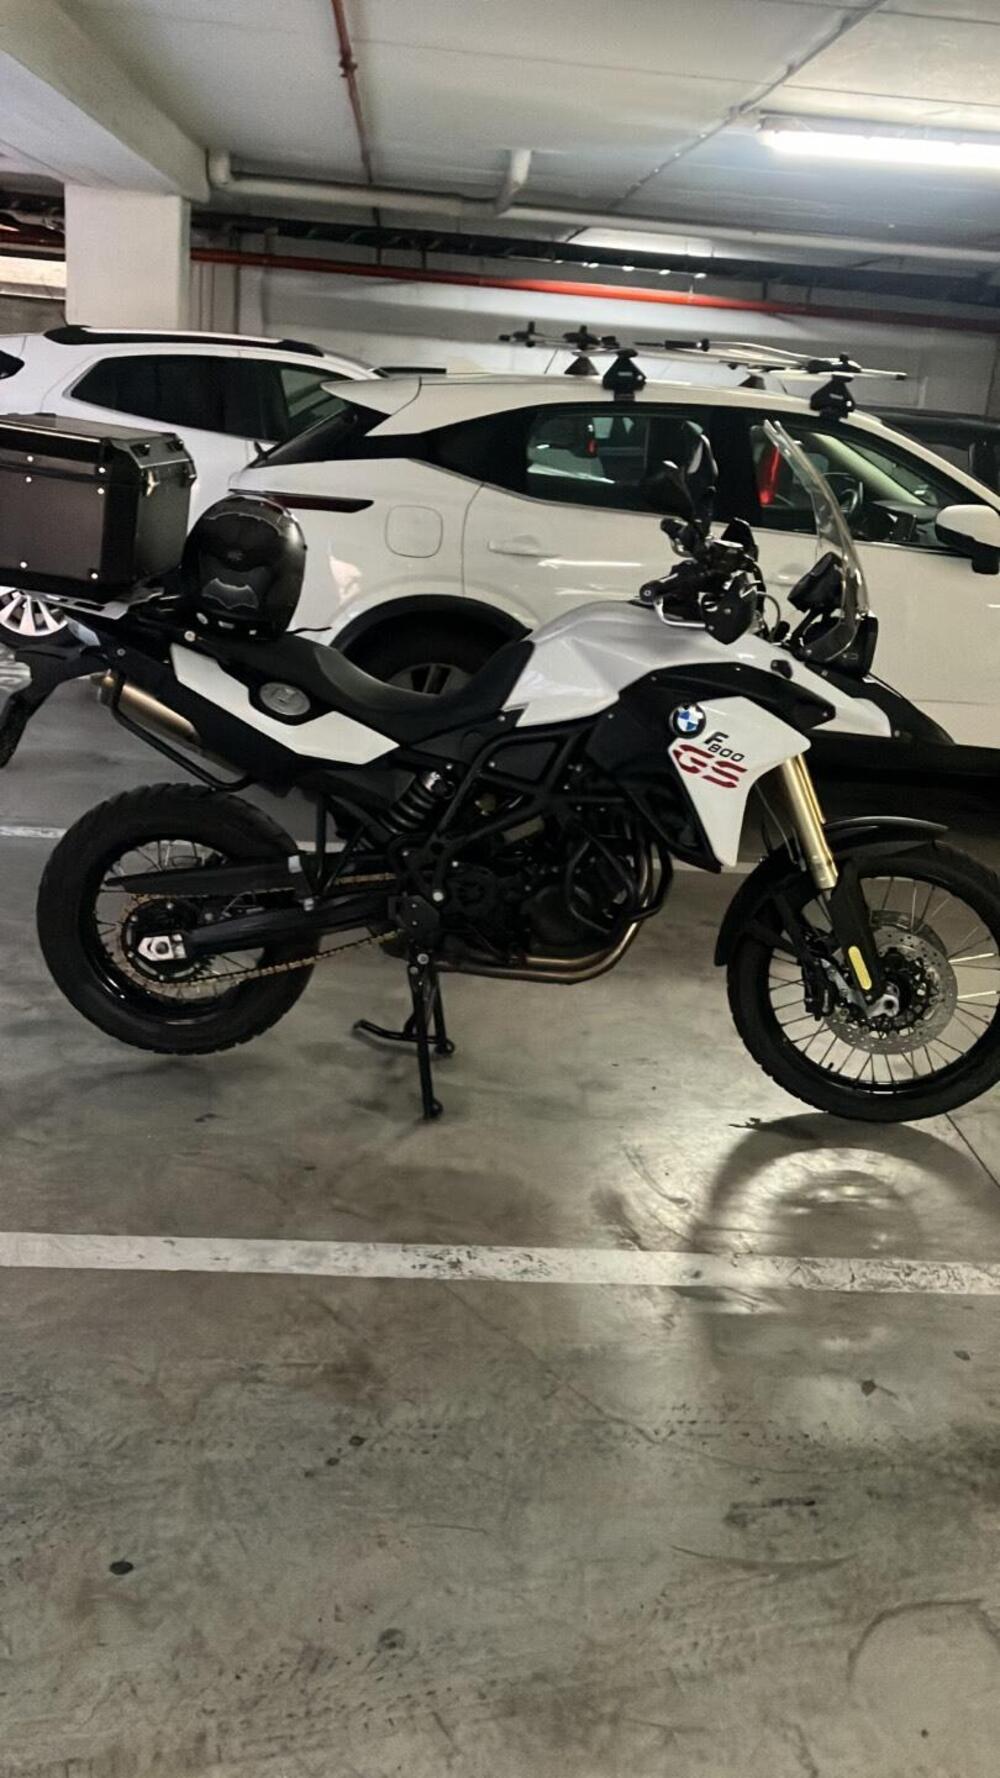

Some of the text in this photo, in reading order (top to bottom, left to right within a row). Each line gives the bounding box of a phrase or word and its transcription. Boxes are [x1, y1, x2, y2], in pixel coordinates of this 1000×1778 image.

[704, 731, 729, 745] F
[707, 743, 745, 762] 800
[672, 744, 748, 788] GS
